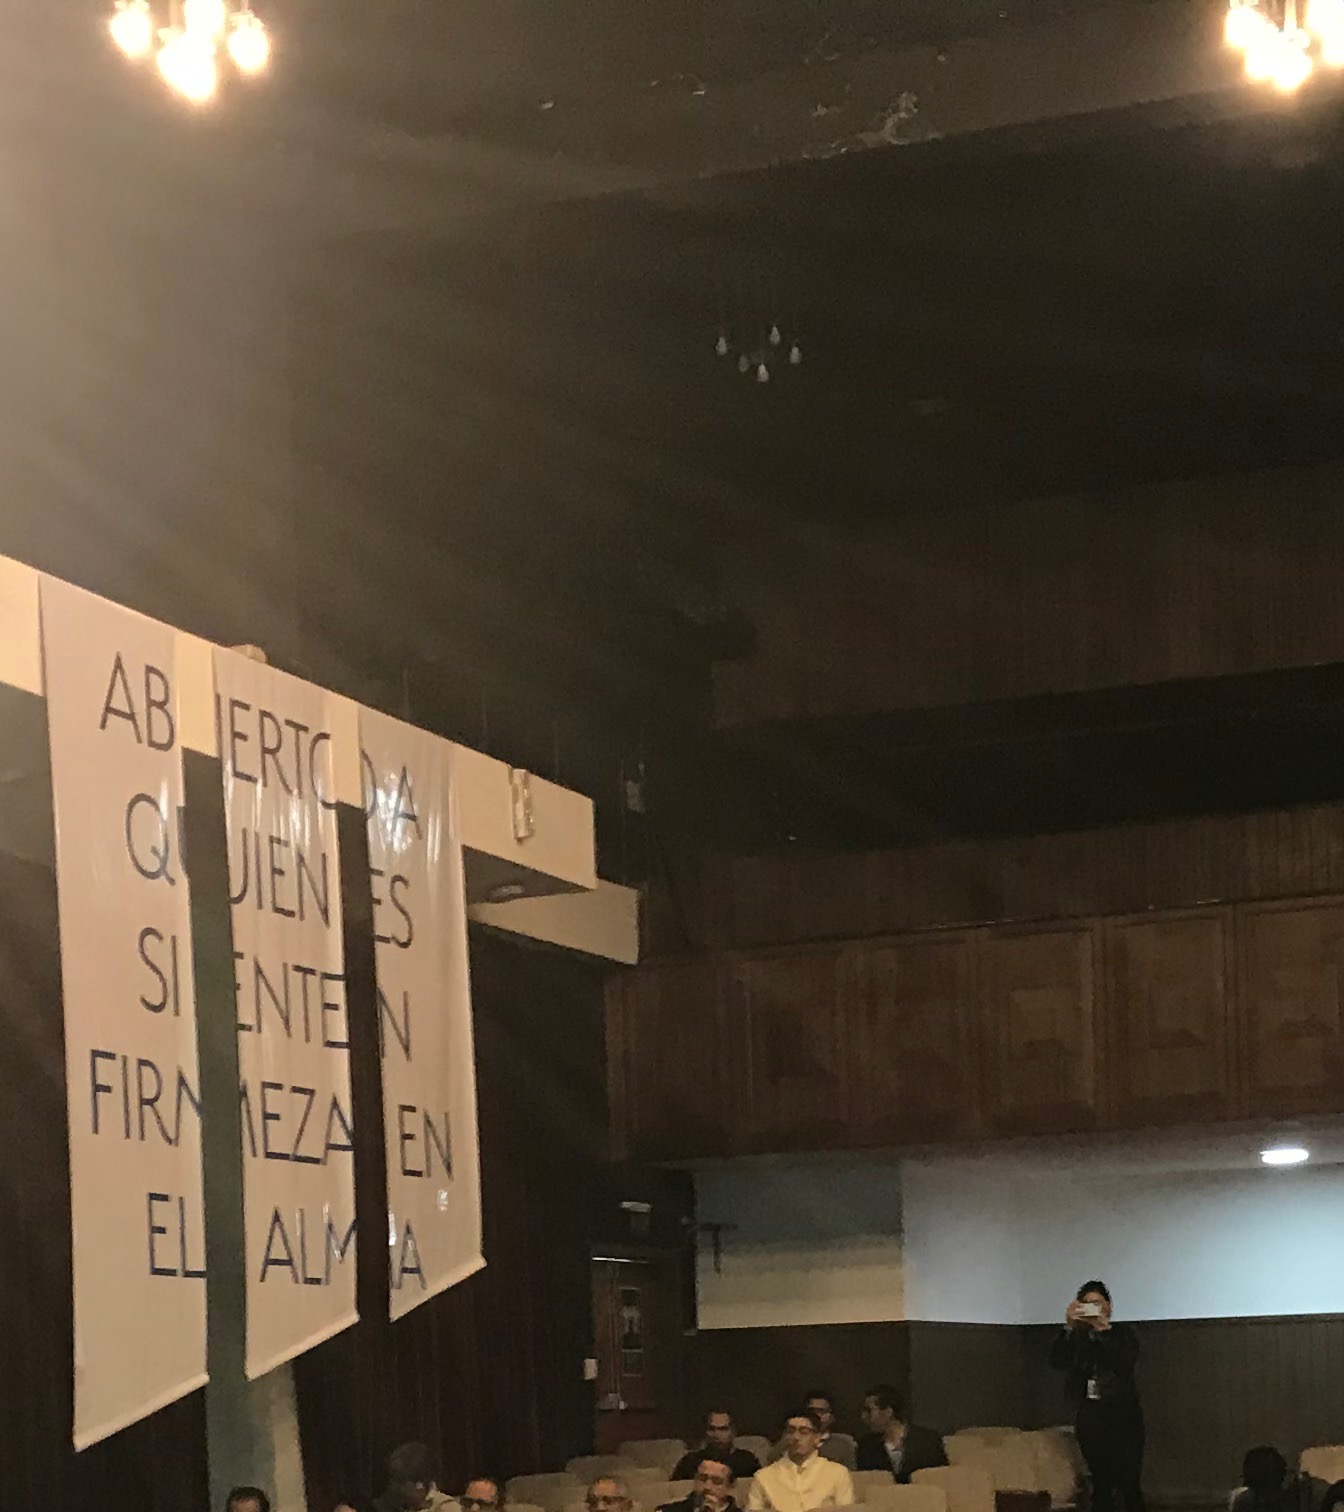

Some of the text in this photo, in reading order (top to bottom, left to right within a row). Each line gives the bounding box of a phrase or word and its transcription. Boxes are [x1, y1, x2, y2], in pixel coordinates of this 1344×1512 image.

[392, 765, 423, 840] A
[398, 1103, 454, 1181] EN
[147, 1191, 427, 1290] EL ALMA
